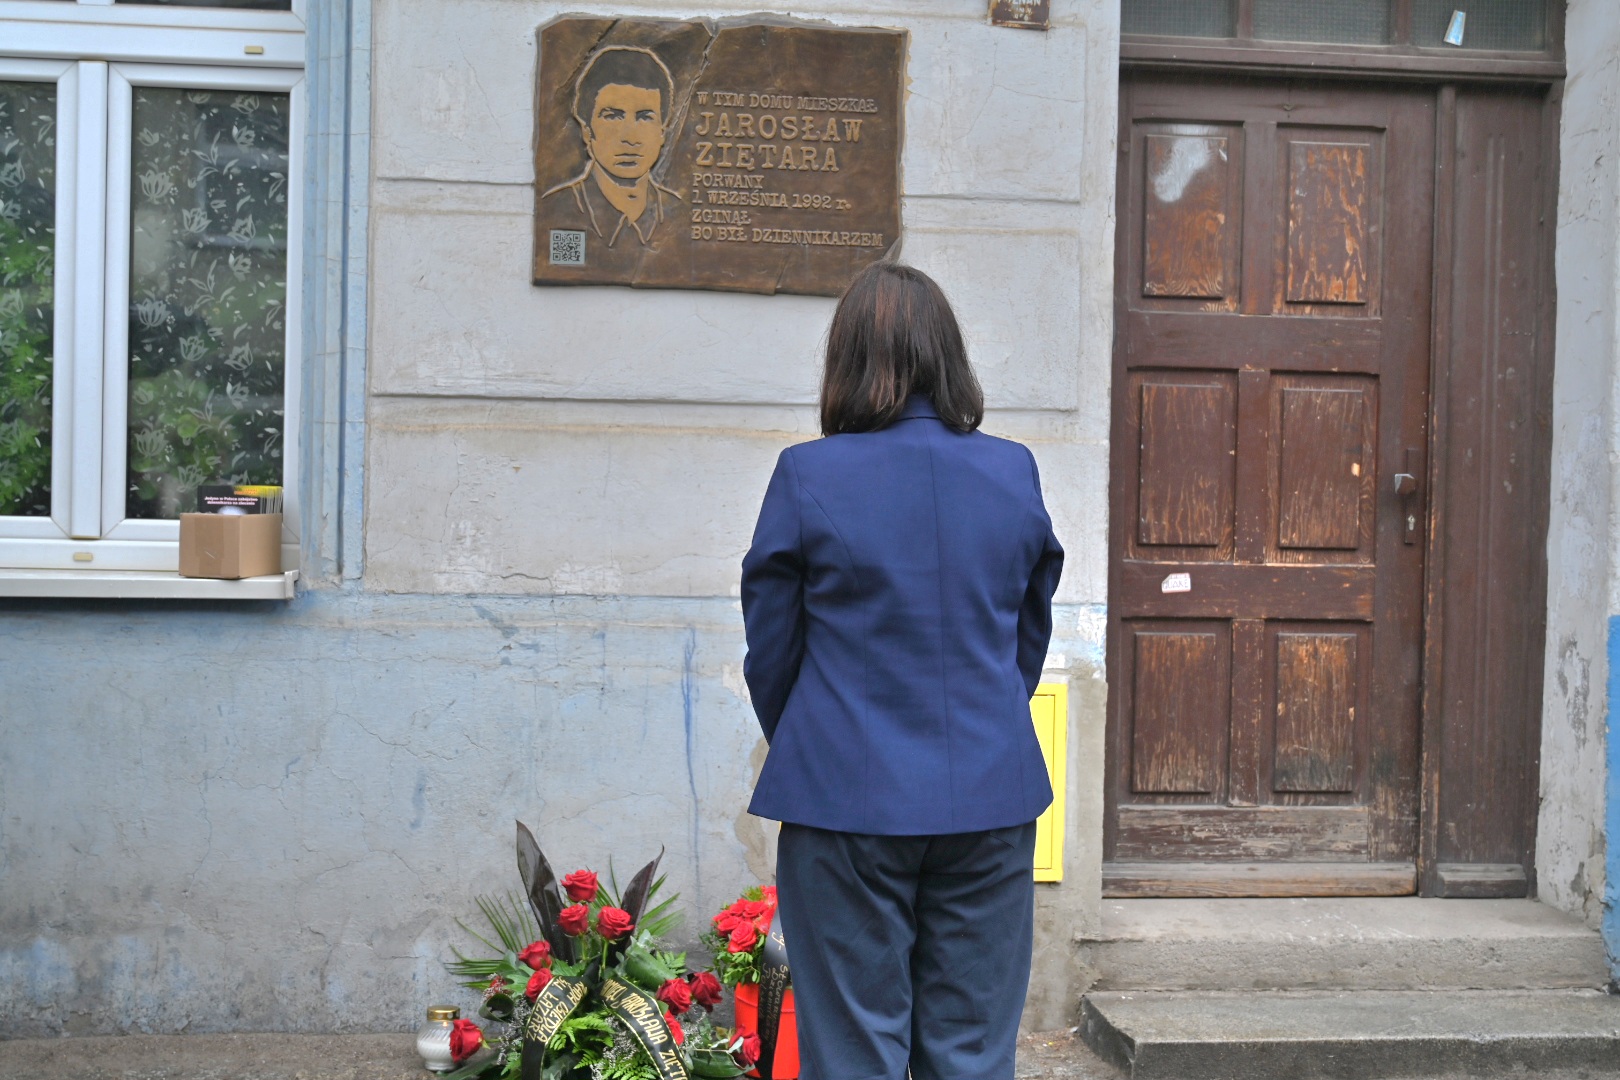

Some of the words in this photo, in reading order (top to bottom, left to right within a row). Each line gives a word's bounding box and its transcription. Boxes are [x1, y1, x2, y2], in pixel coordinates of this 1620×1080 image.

[696, 91, 709, 106] W
[713, 92, 744, 108] TYM
[749, 93, 793, 110] DOMU
[797, 96, 878, 114] MIESZKAŁ
[695, 111, 864, 143] JAROSŁAW
[695, 141, 840, 172] ZIĘTARA
[692, 172, 765, 190] PORWANY
[691, 190, 703, 204] 1
[706, 189, 788, 208] WRZEŚNIA
[792, 193, 832, 210] 1992
[835, 199, 852, 211] r.
[691, 209, 751, 226] ZGINĄŁ
[691, 226, 712, 241] BO
[716, 227, 748, 242] BYŁ
[751, 228, 884, 247] DZIENNIKARZEM
[526, 991, 559, 1042] ŁAZARZ
[537, 1001, 569, 1043] OSIEDLA
[611, 992, 668, 1045] JAROSŁAWA
